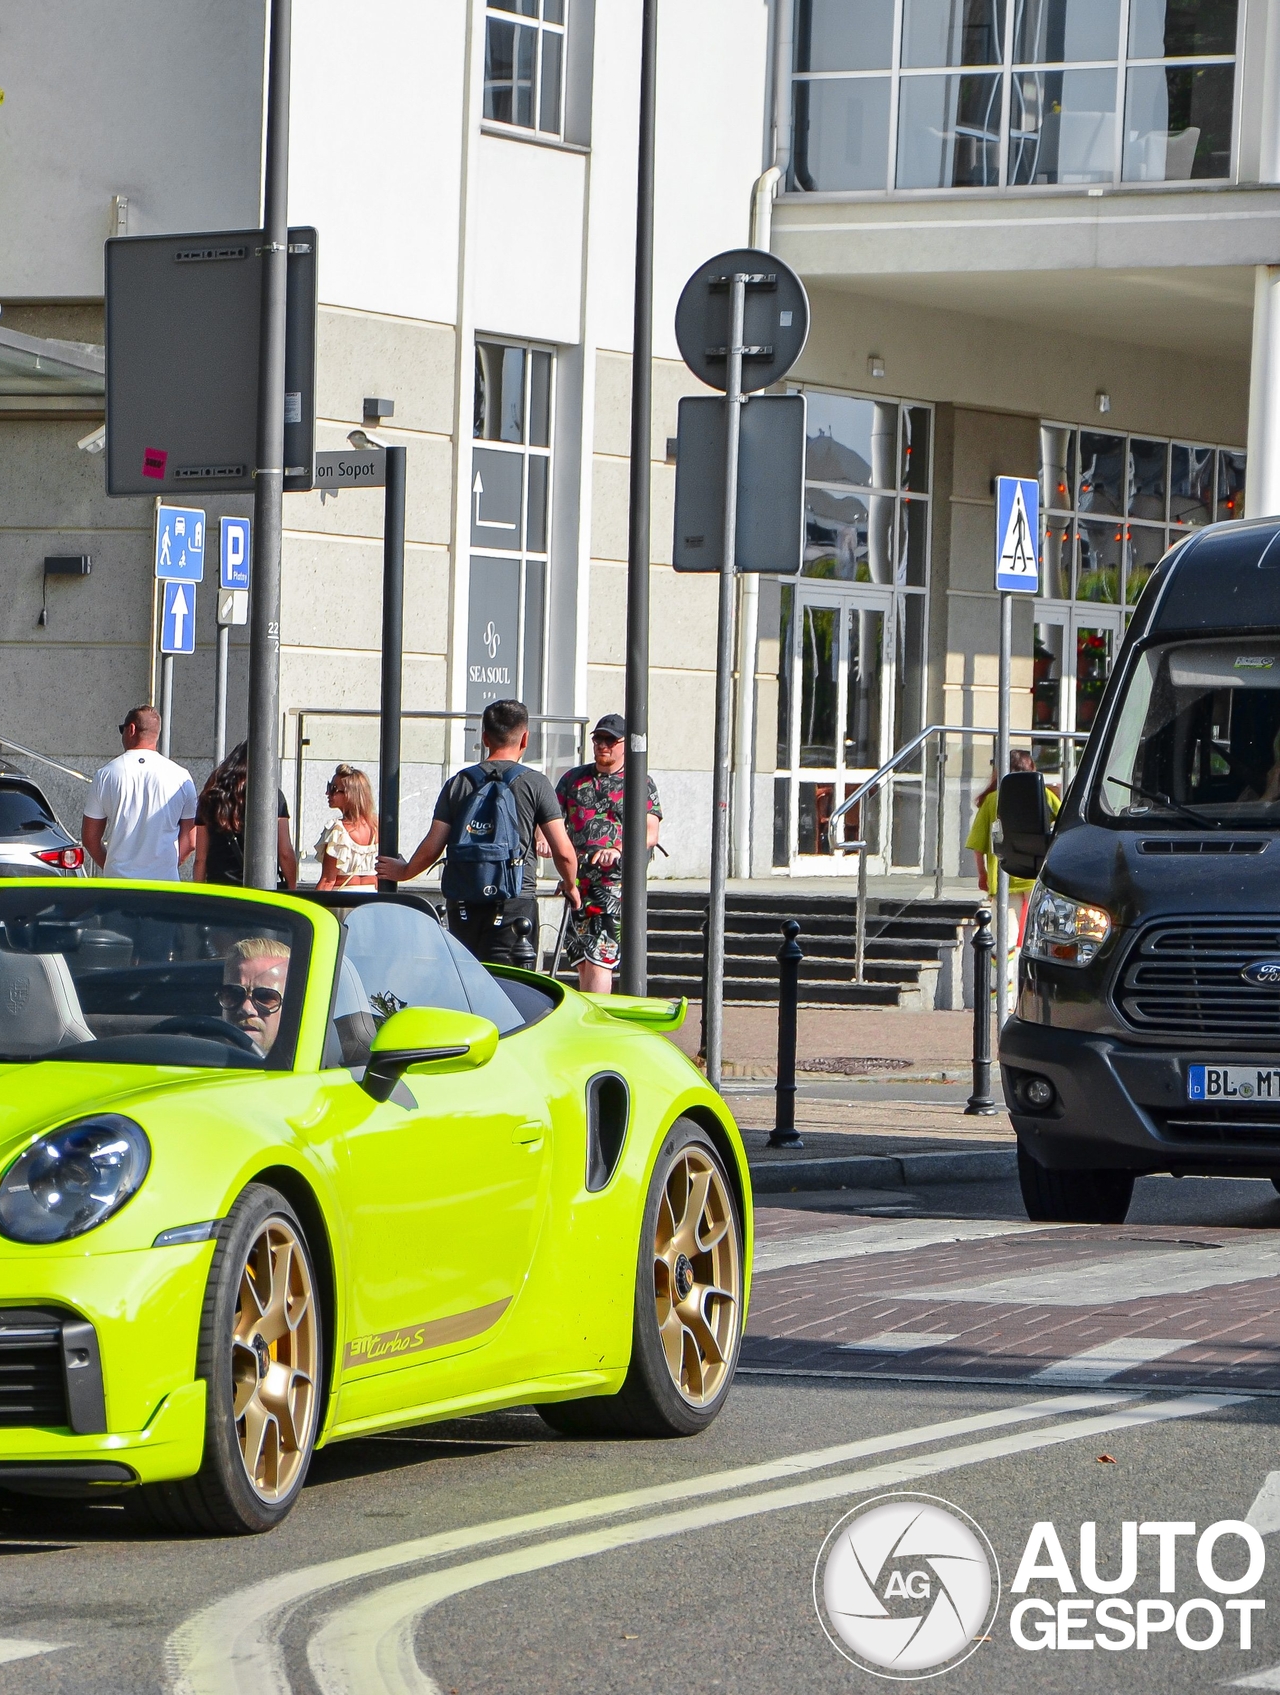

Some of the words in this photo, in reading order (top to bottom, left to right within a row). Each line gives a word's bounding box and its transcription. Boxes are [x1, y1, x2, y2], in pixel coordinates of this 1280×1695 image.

[338, 462, 375, 480] Sopot
[227, 525, 245, 581] P
[268, 622, 279, 634] 22
[274, 640, 280, 653] 2
[469, 665, 486, 683] SEA
[487, 667, 511, 685] SOUL
[1194, 1085, 1201, 1094] D
[1207, 1070, 1238, 1096] BL
[349, 1335, 373, 1357] 911
[410, 1328, 425, 1348] S
